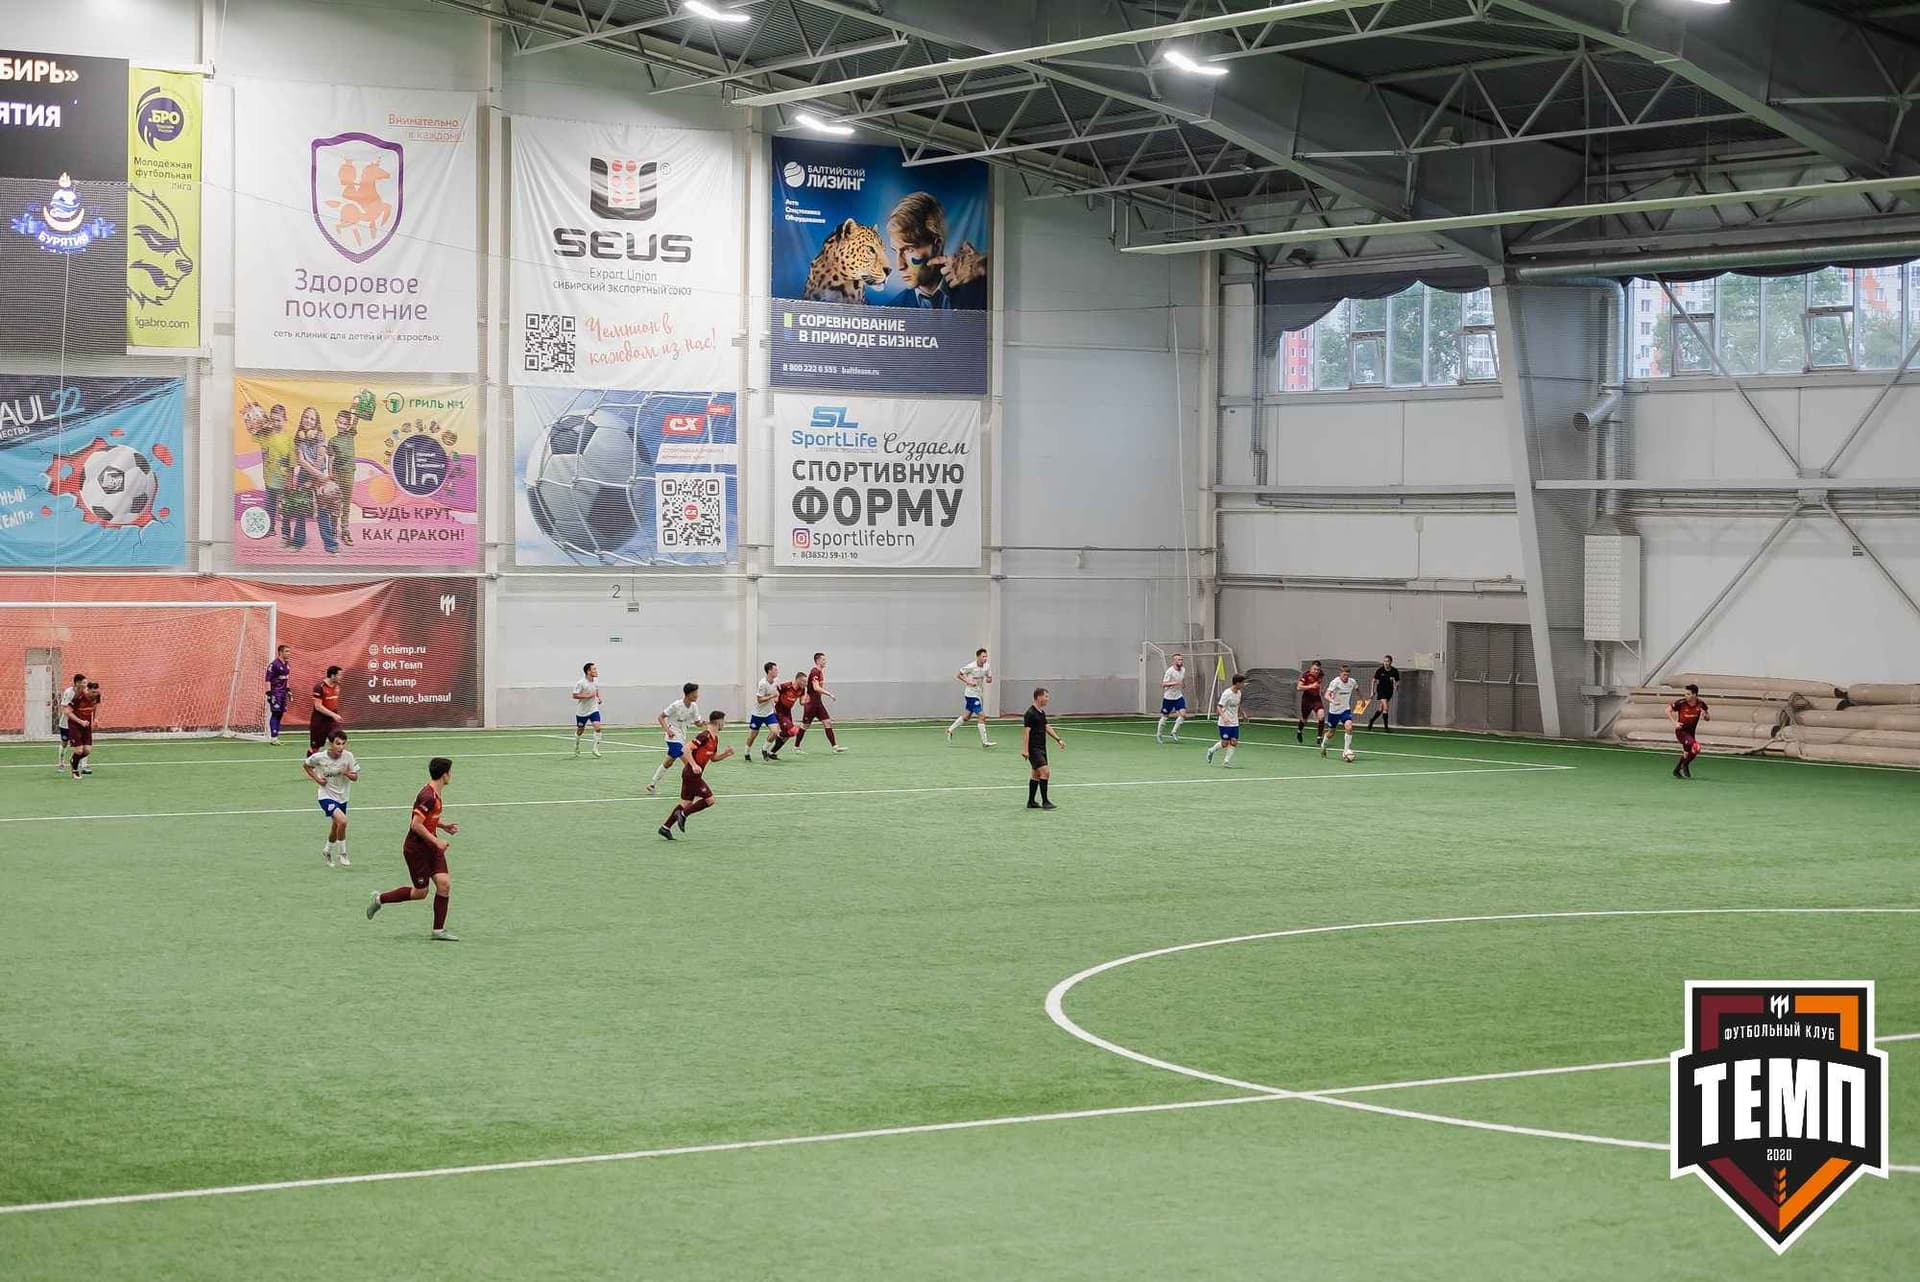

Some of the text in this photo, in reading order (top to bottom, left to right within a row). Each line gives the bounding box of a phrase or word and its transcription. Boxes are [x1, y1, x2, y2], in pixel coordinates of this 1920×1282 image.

[388, 113, 460, 127] Внимательно
[135, 168, 192, 180] футбольная
[807, 165, 866, 177] БАЛТИЙСКИЙ
[171, 181, 192, 191] лига
[806, 173, 866, 191] ЛИЗИНГ
[553, 228, 693, 263] SEUS
[590, 267, 657, 281] Export Union
[295, 268, 419, 296] Здоровое
[553, 280, 692, 296] СИБИРСКИЙ ЭКСПОРТНЫЙ СОЮЗ
[285, 300, 428, 320] поколение
[585, 316, 659, 341] Чемпион
[799, 314, 906, 331] СОРЕВНОВАНИЕ
[273, 330, 293, 338] сеть
[295, 331, 328, 339] клиник
[330, 331, 346, 341] для
[348, 332, 374, 342] детей
[397, 333, 441, 344] взрослых
[799, 330, 939, 349] В ПРИРОДЕ БИЗНЕСА
[590, 328, 716, 366] каждом из нас!
[409, 399, 465, 409] ГРИЛЬ №1
[791, 430, 878, 448] SportLife
[883, 432, 970, 461] Создаем
[792, 460, 965, 484] СПОРТИВНУЮ
[362, 507, 456, 521] БУДЬ КРУТ,
[792, 486, 963, 527] ФОРМУ
[362, 528, 465, 543] КАК ДРАКОН!
[813, 530, 915, 549] sportlifebrn
[800, 551, 828, 560] 8(3852)
[829, 551, 858, 559] 59-11-10
[612, 584, 621, 599] 2
[383, 645, 426, 655] fctemp.ru
[382, 661, 423, 670] ФК Темп
[382, 677, 417, 688] fc.temp
[383, 692, 452, 704] fctemp_barnaul
